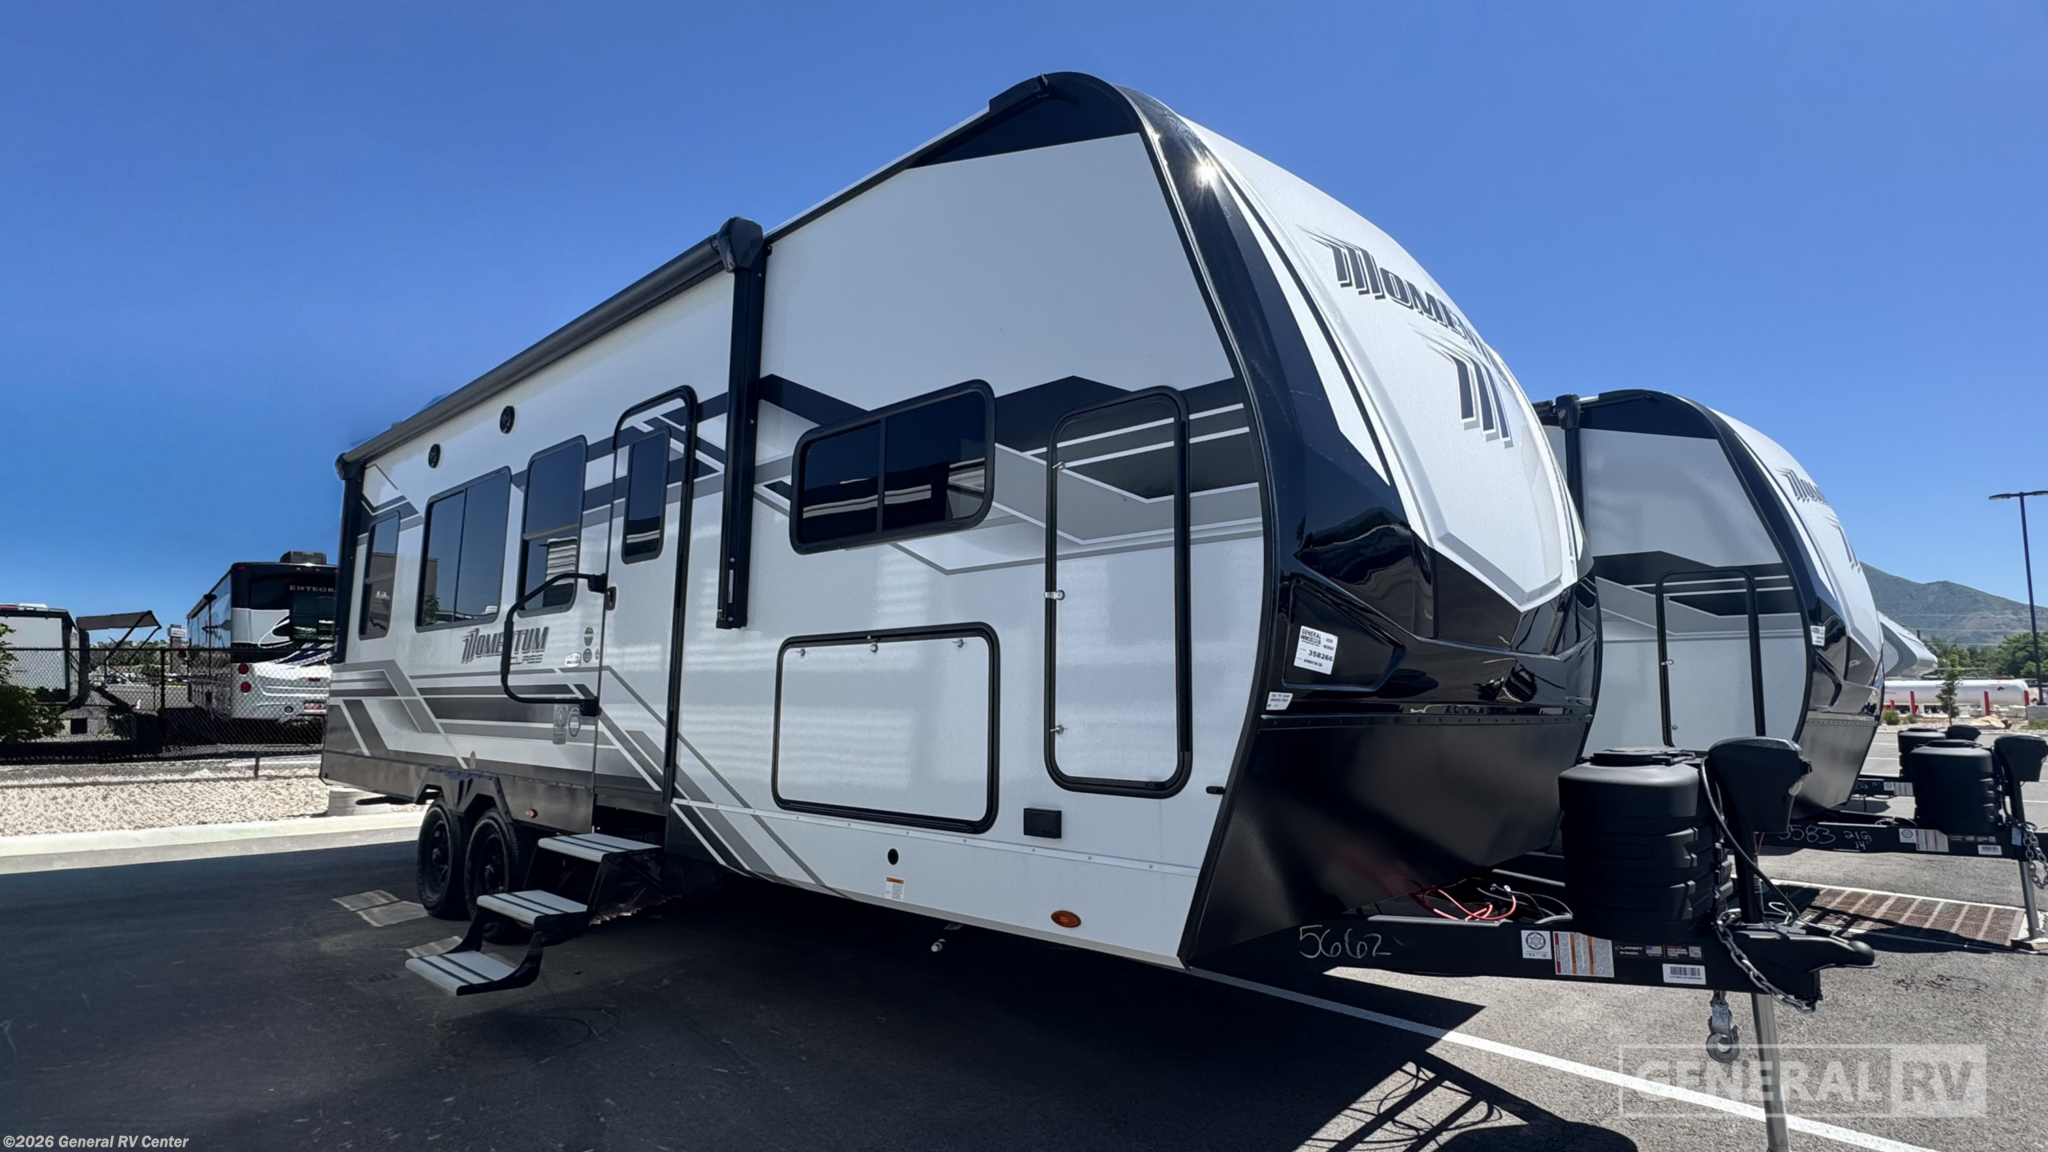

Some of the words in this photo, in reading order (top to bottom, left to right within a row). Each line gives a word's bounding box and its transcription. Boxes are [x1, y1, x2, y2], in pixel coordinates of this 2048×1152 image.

[1302, 229, 1512, 390] MOMEN
[461, 626, 550, 665] MOMETUM
[1301, 628, 1321, 639] GENERAL
[1308, 650, 1333, 662] 358266
[1299, 924, 1392, 959] 5662
